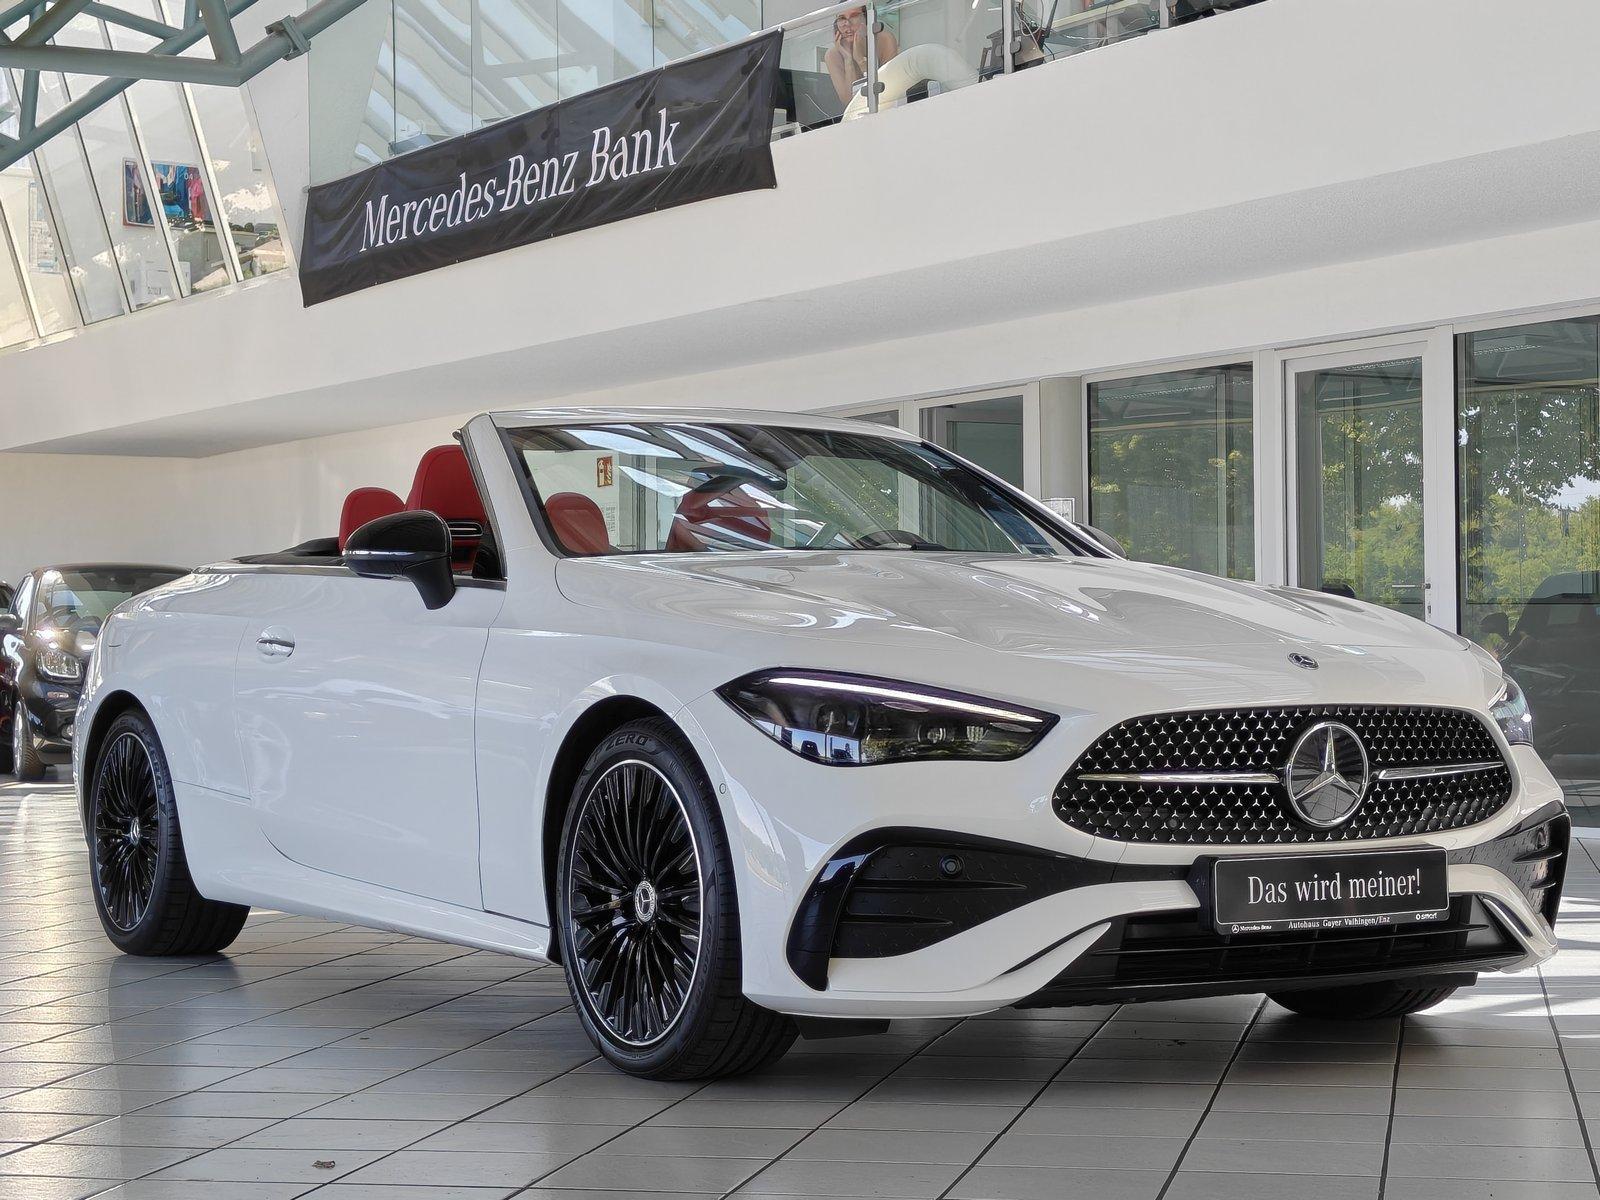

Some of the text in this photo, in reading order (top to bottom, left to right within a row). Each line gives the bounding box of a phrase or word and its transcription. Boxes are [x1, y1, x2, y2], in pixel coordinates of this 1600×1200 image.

[359, 108, 680, 252] Mercedes-Benz Bank
[1248, 868, 1421, 904] Das wird meiner!
[1288, 920, 1320, 929] Autohaus
[1344, 915, 1391, 926] Vaihingen/Enz
